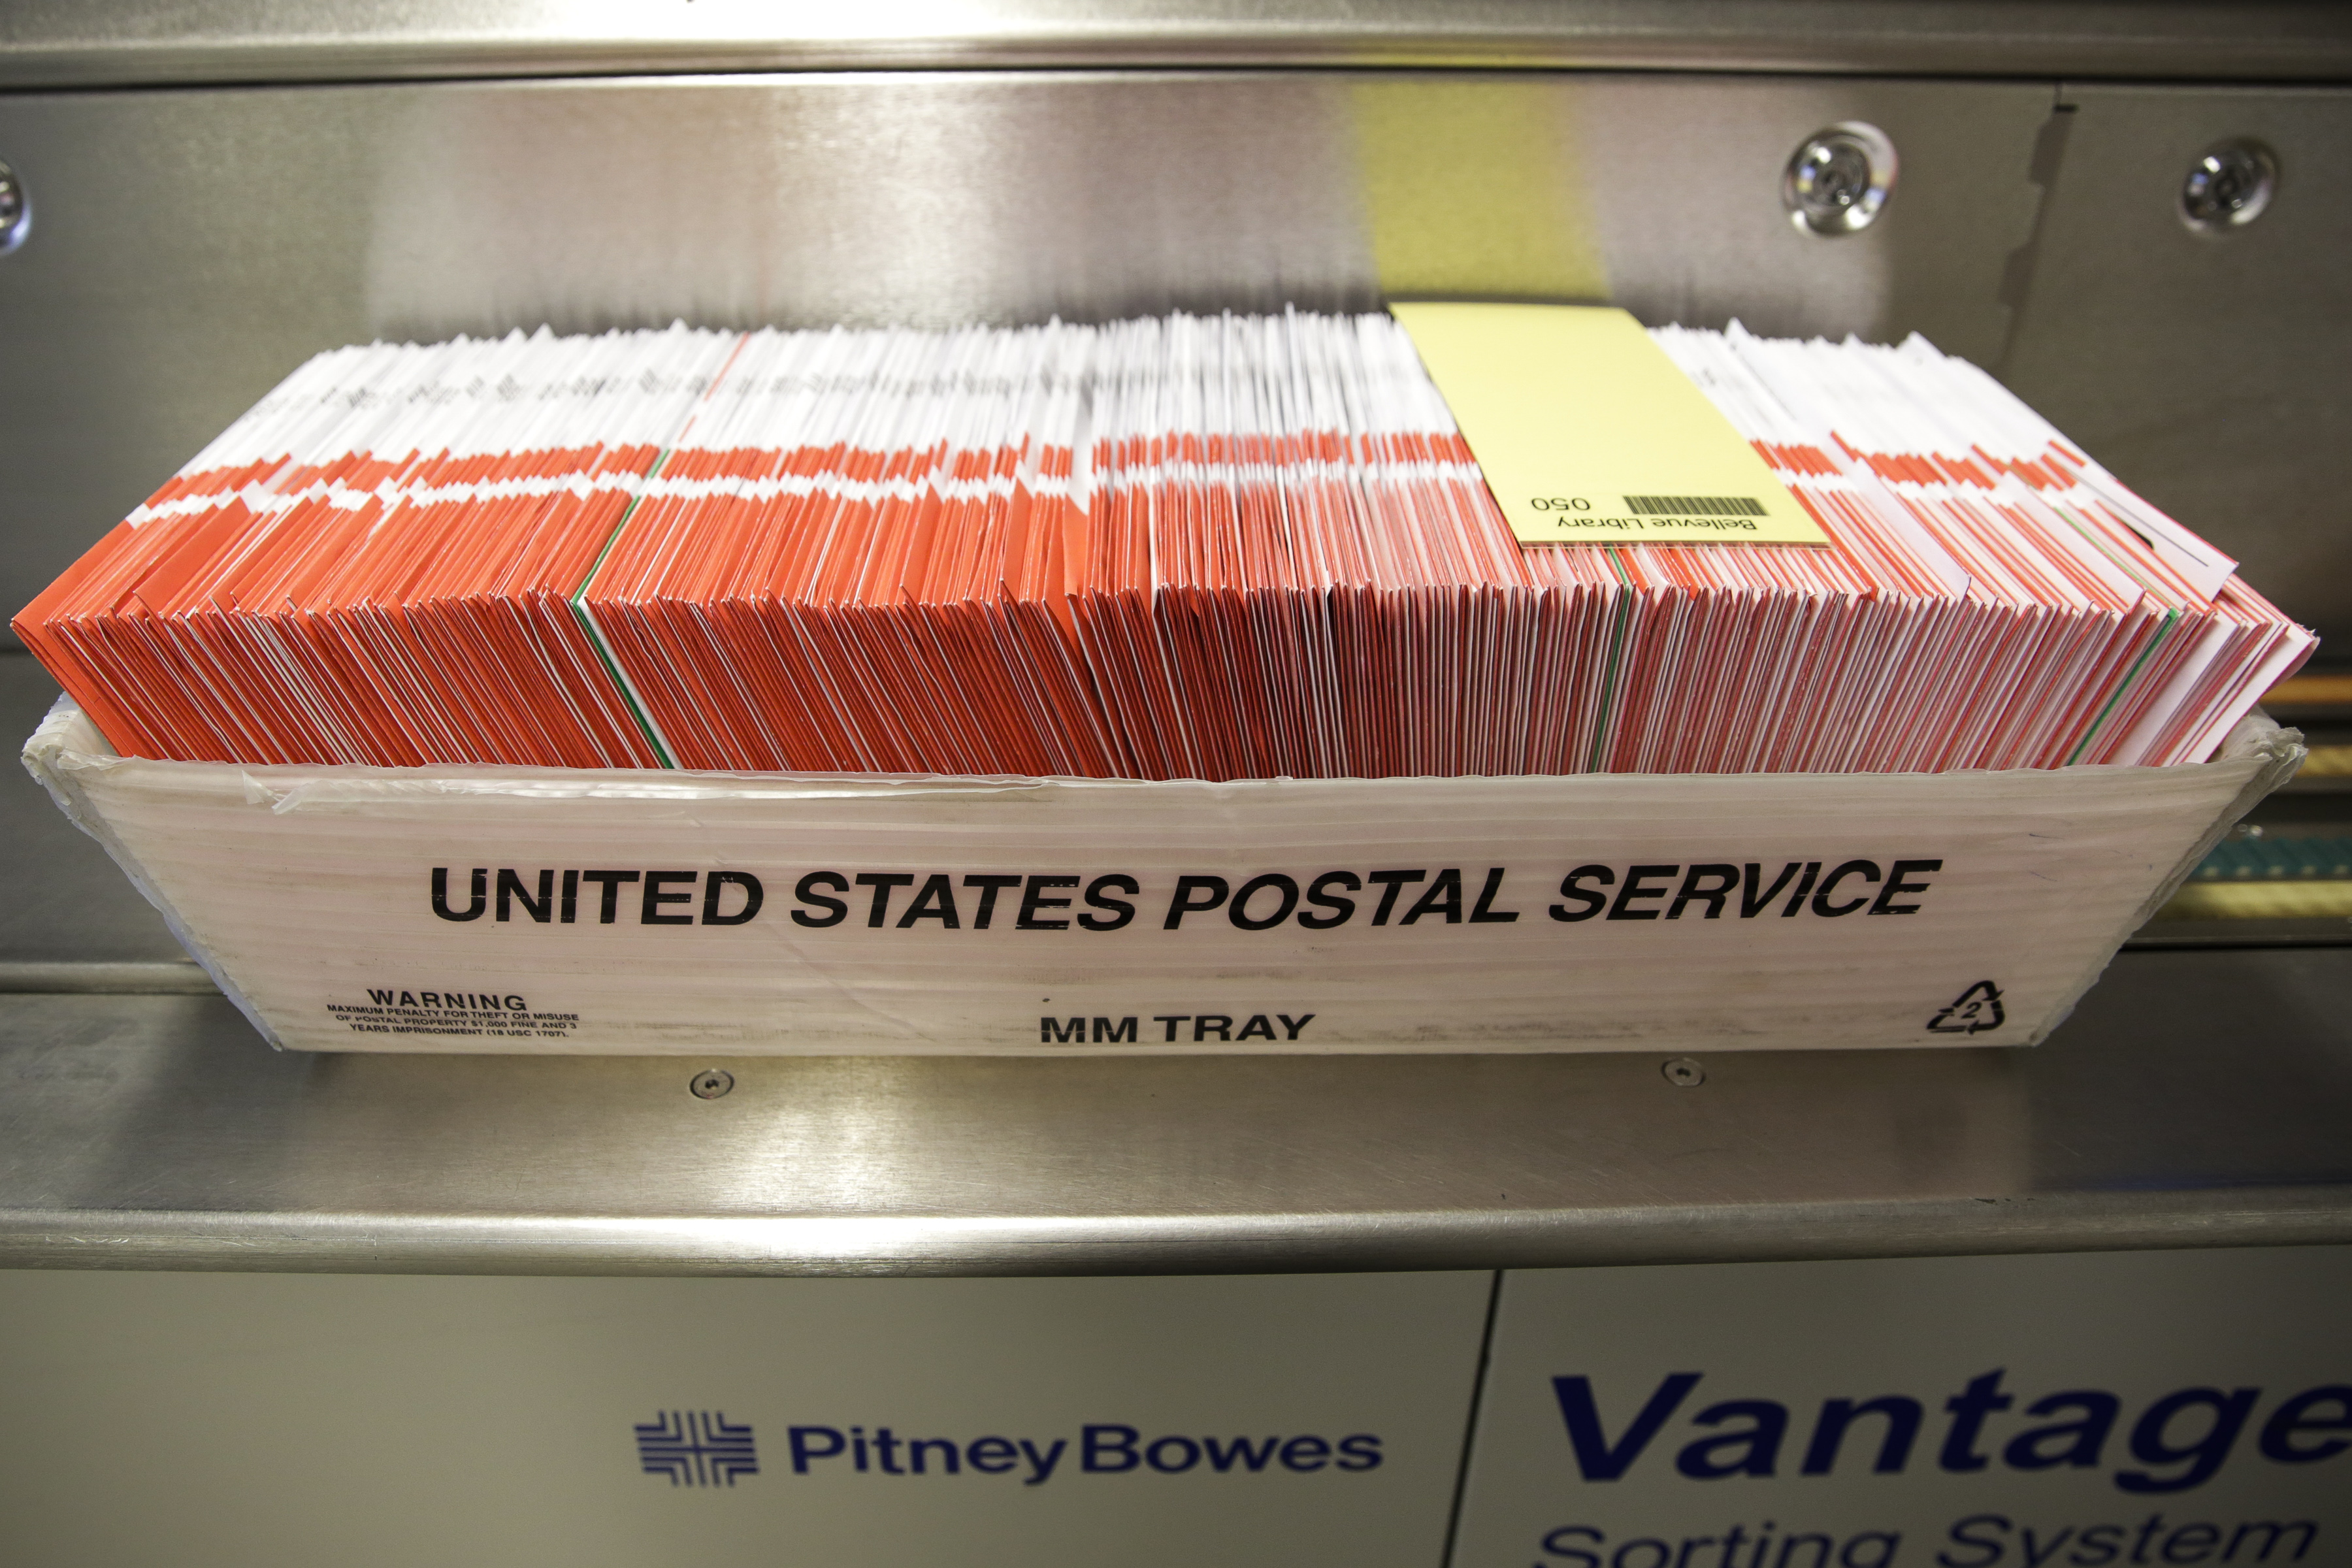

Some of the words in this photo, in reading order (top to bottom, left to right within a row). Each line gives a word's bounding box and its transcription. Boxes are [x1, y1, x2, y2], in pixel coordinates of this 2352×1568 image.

[1531, 497, 1591, 511] 050
[1558, 516, 1644, 530] Library
[1650, 518, 1757, 530] Bellevue
[431, 867, 764, 926] UNITED
[791, 871, 1141, 932] STATES
[1163, 868, 1520, 931] POSTAL
[1548, 859, 1943, 923] SERVICE
[367, 988, 527, 1011] WARNING
[327, 1004, 384, 1015] MAXIMUM
[387, 1008, 440, 1018] PENALTY
[443, 1010, 468, 1019] FOR
[470, 1011, 508, 1020] THEFT
[512, 1012, 531, 1021] OR
[534, 1013, 580, 1022] MISUSE
[355, 1016, 401, 1024] POSTAL
[404, 1018, 466, 1027] PROPERTY
[349, 1023, 390, 1034] YEARS
[393, 1025, 483, 1036] IMPRISONMENT
[1041, 1017, 1138, 1043] MM
[1153, 1014, 1316, 1042] TRAY
[1550, 1367, 2352, 1495] Vantage
[1936, 1512, 2320, 1568] System
